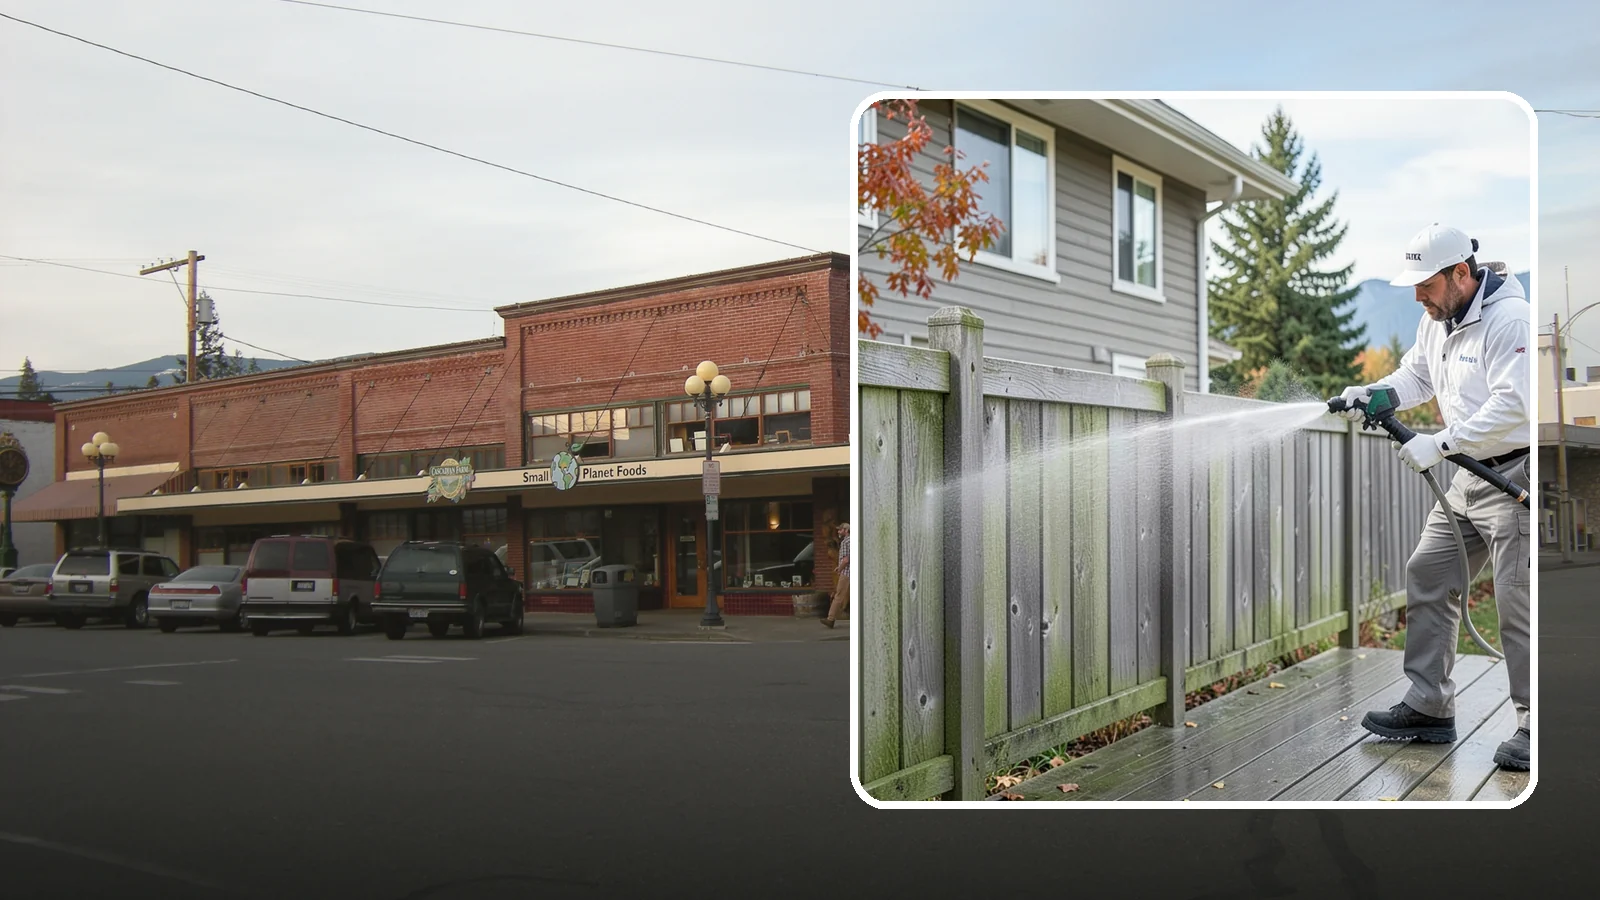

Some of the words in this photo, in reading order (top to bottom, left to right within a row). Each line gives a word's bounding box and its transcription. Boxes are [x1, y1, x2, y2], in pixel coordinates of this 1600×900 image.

[523, 471, 549, 482] Small
[582, 468, 614, 479] Planet
[616, 464, 647, 476] Foods
